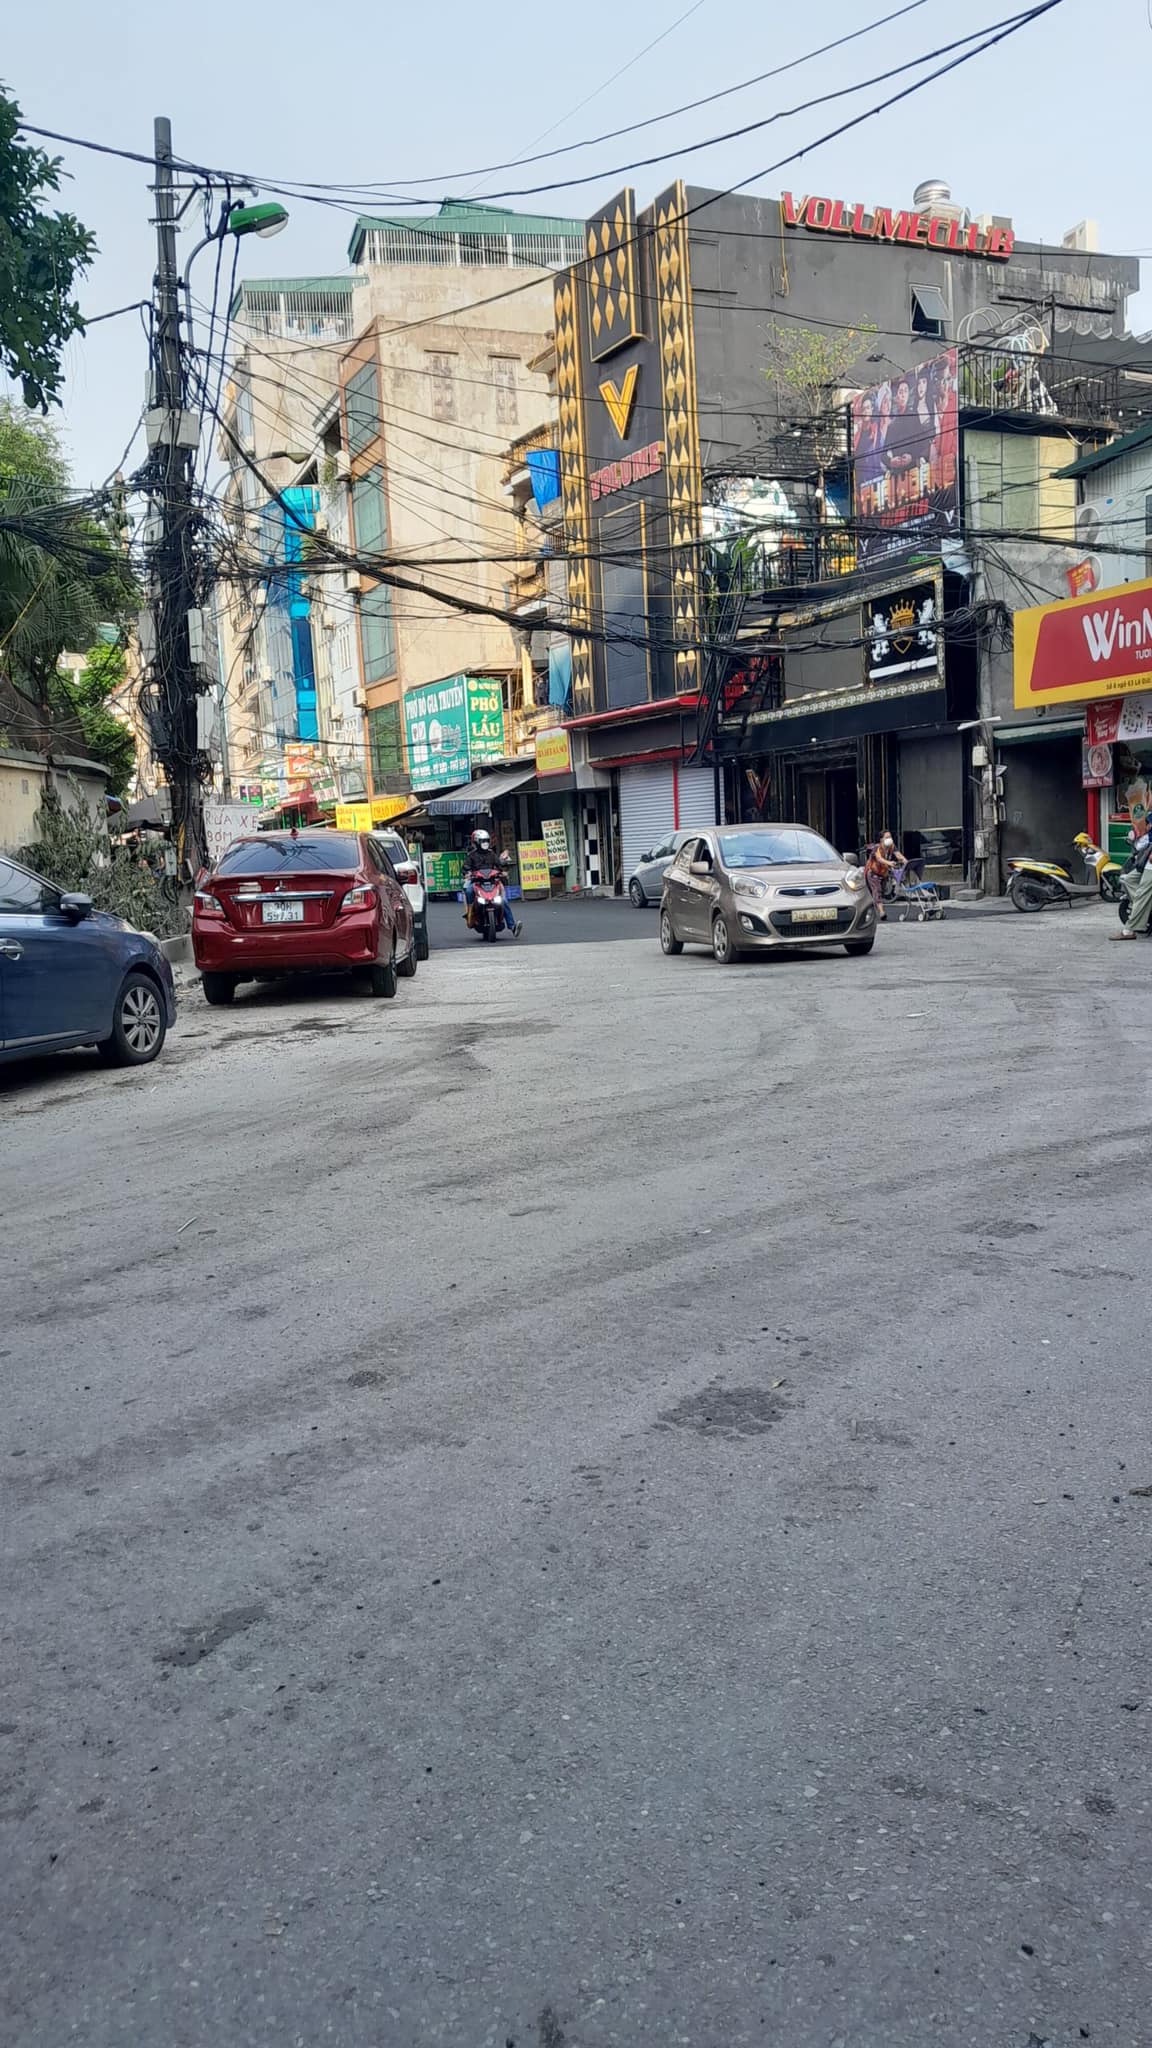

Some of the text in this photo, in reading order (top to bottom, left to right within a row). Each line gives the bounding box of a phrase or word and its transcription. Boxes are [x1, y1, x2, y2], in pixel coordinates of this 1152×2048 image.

[469, 691, 499, 712] PHỞ
[239, 815, 258, 829] XE
[544, 829, 565, 839] BÁNH
[546, 838, 566, 847] CUỐN
